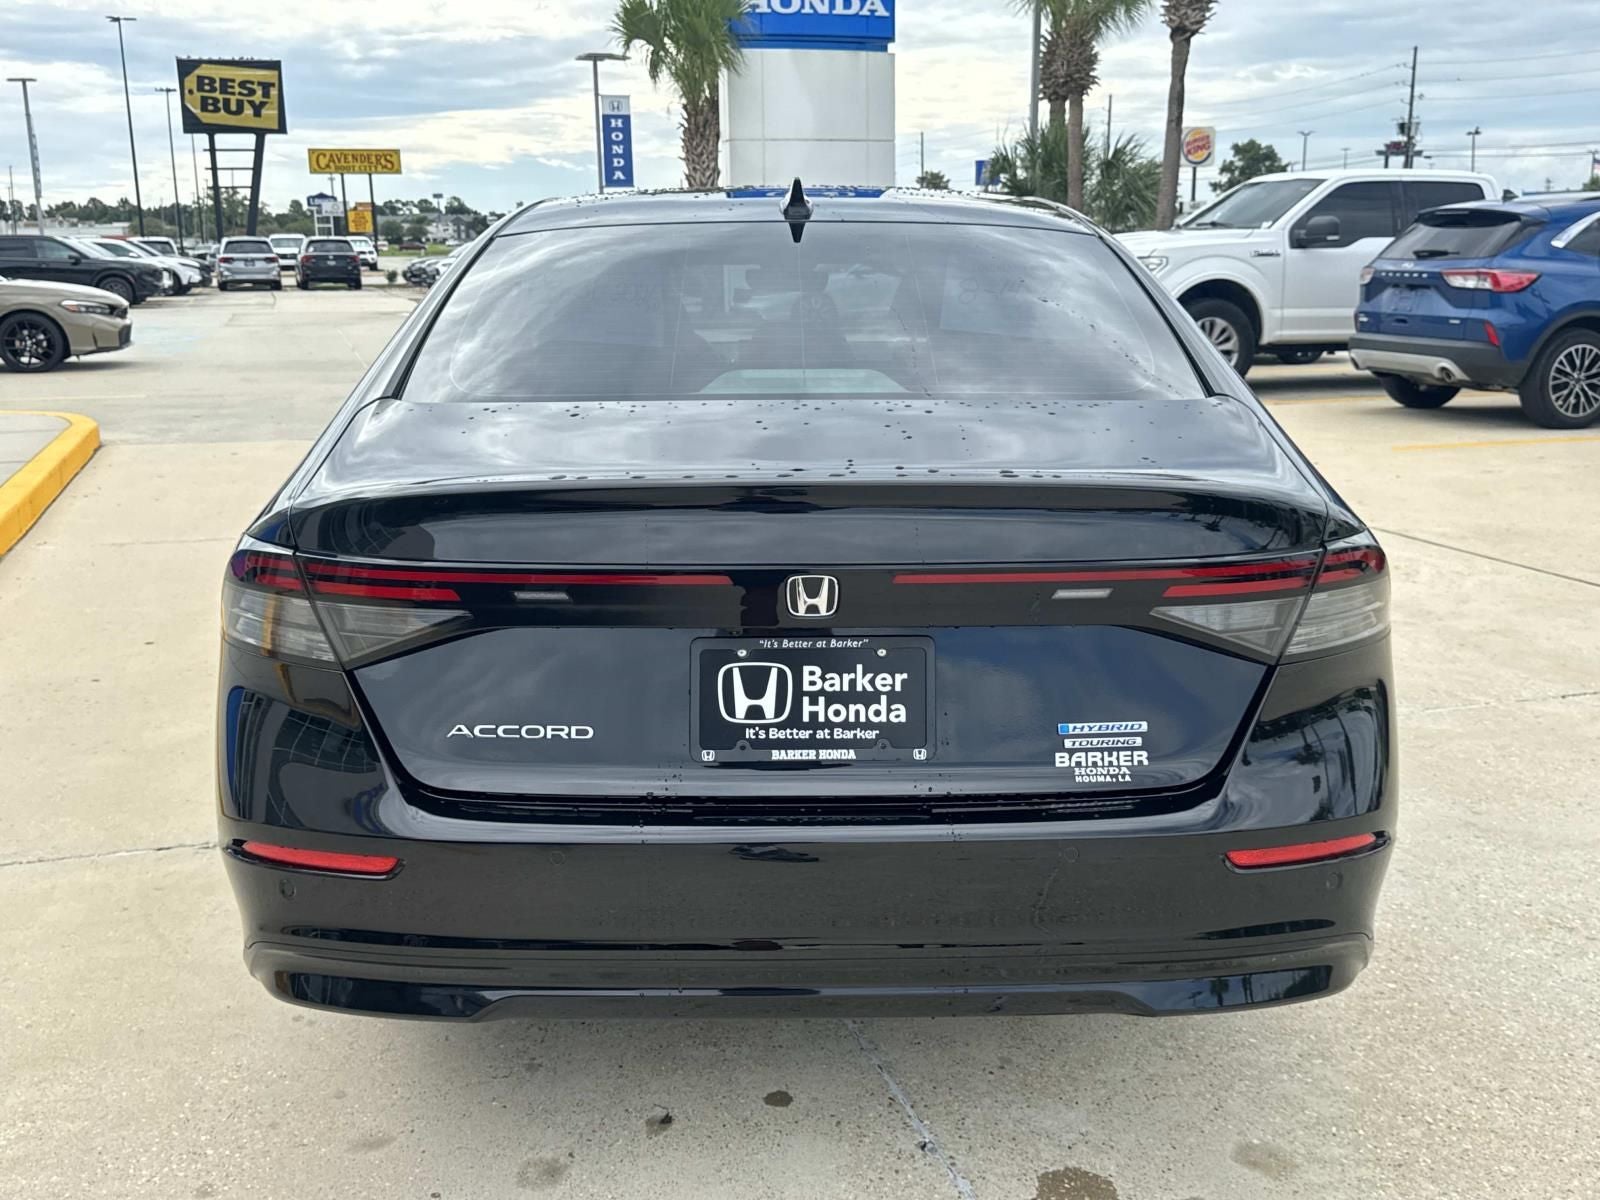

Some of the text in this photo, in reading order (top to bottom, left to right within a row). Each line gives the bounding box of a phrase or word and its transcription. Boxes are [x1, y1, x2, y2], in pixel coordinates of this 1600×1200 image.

[196, 75, 276, 99] BEST
[200, 95, 270, 118] BUY
[609, 118, 627, 180] HONDA
[315, 152, 395, 171] CAVENDER'S
[782, 638, 813, 648] Better
[816, 639, 827, 648] at
[802, 664, 908, 692] Barker
[802, 695, 907, 723] Honda
[446, 724, 594, 739] ACCORD
[745, 726, 880, 739] It's Better at Barker
[1071, 723, 1143, 732] HYBRID
[1068, 738, 1137, 747] TOURING
[771, 749, 857, 760] BARKER HONDA
[1055, 751, 1149, 767] BARKER
[1074, 767, 1131, 775] HONDA
[1118, 774, 1132, 782] LA
